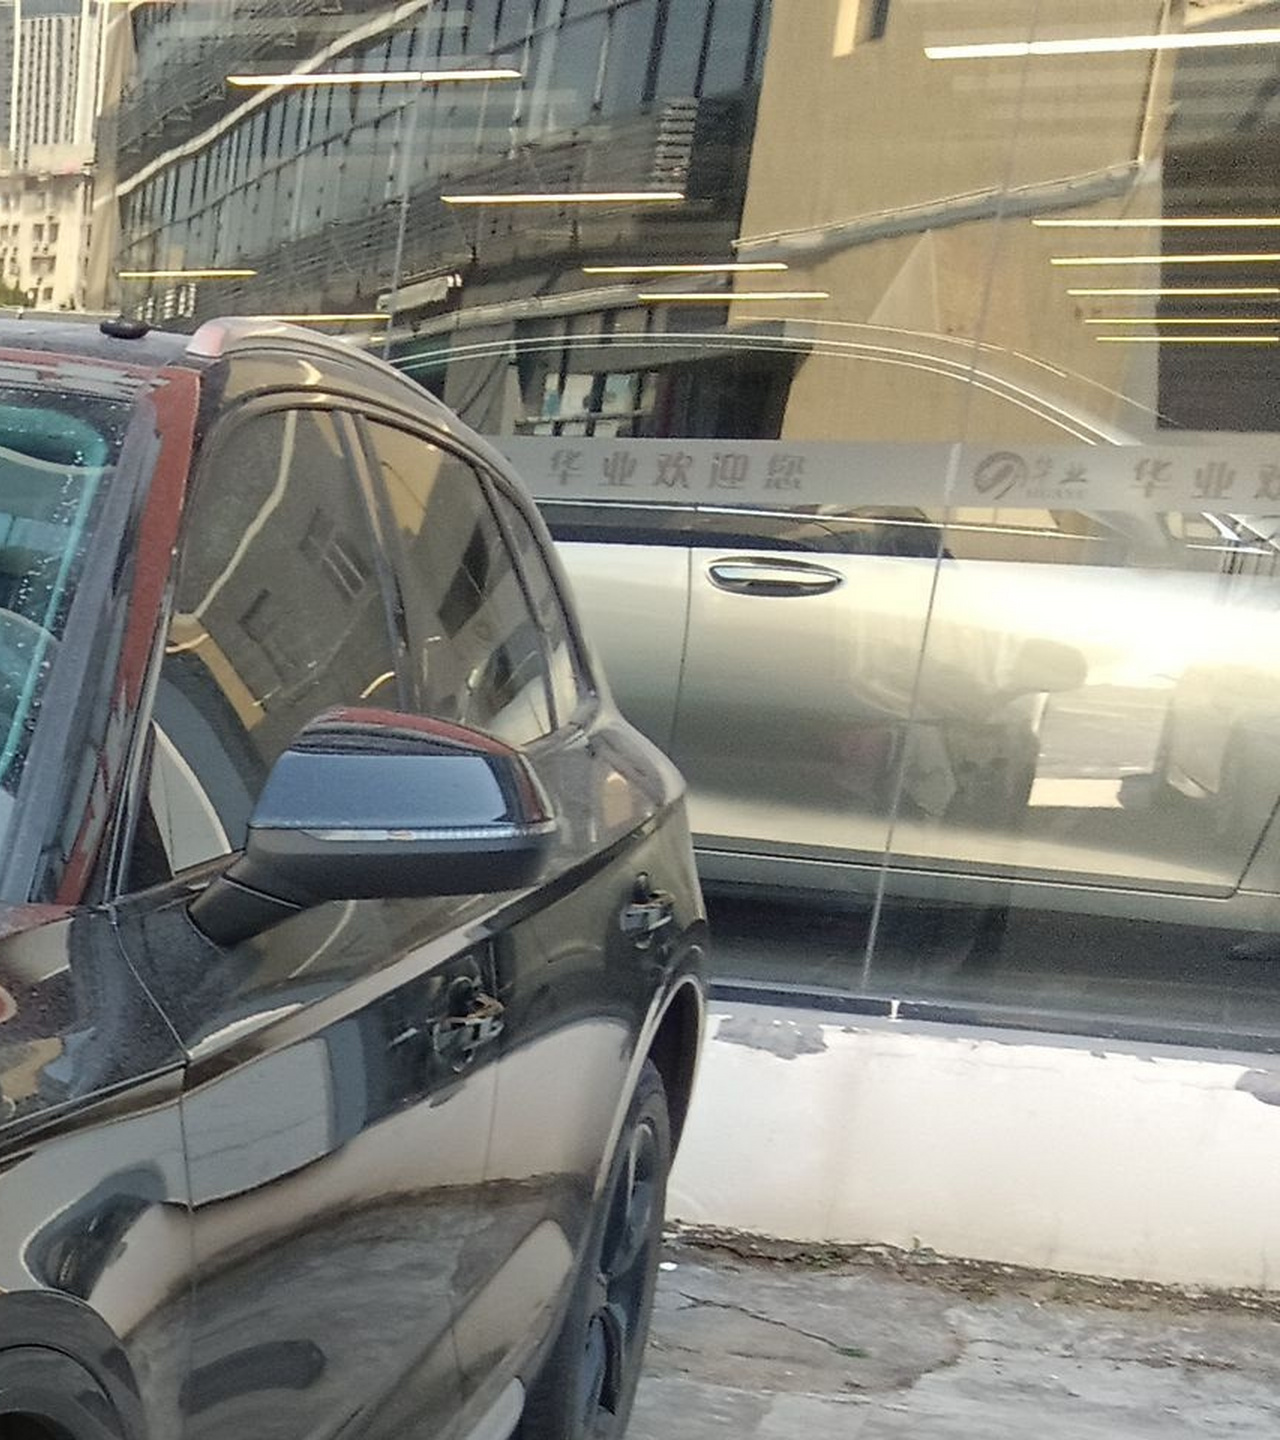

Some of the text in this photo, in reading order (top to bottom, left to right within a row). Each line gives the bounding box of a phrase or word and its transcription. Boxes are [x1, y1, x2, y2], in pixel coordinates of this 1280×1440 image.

[547, 449, 806, 492] 华业欢迎您
